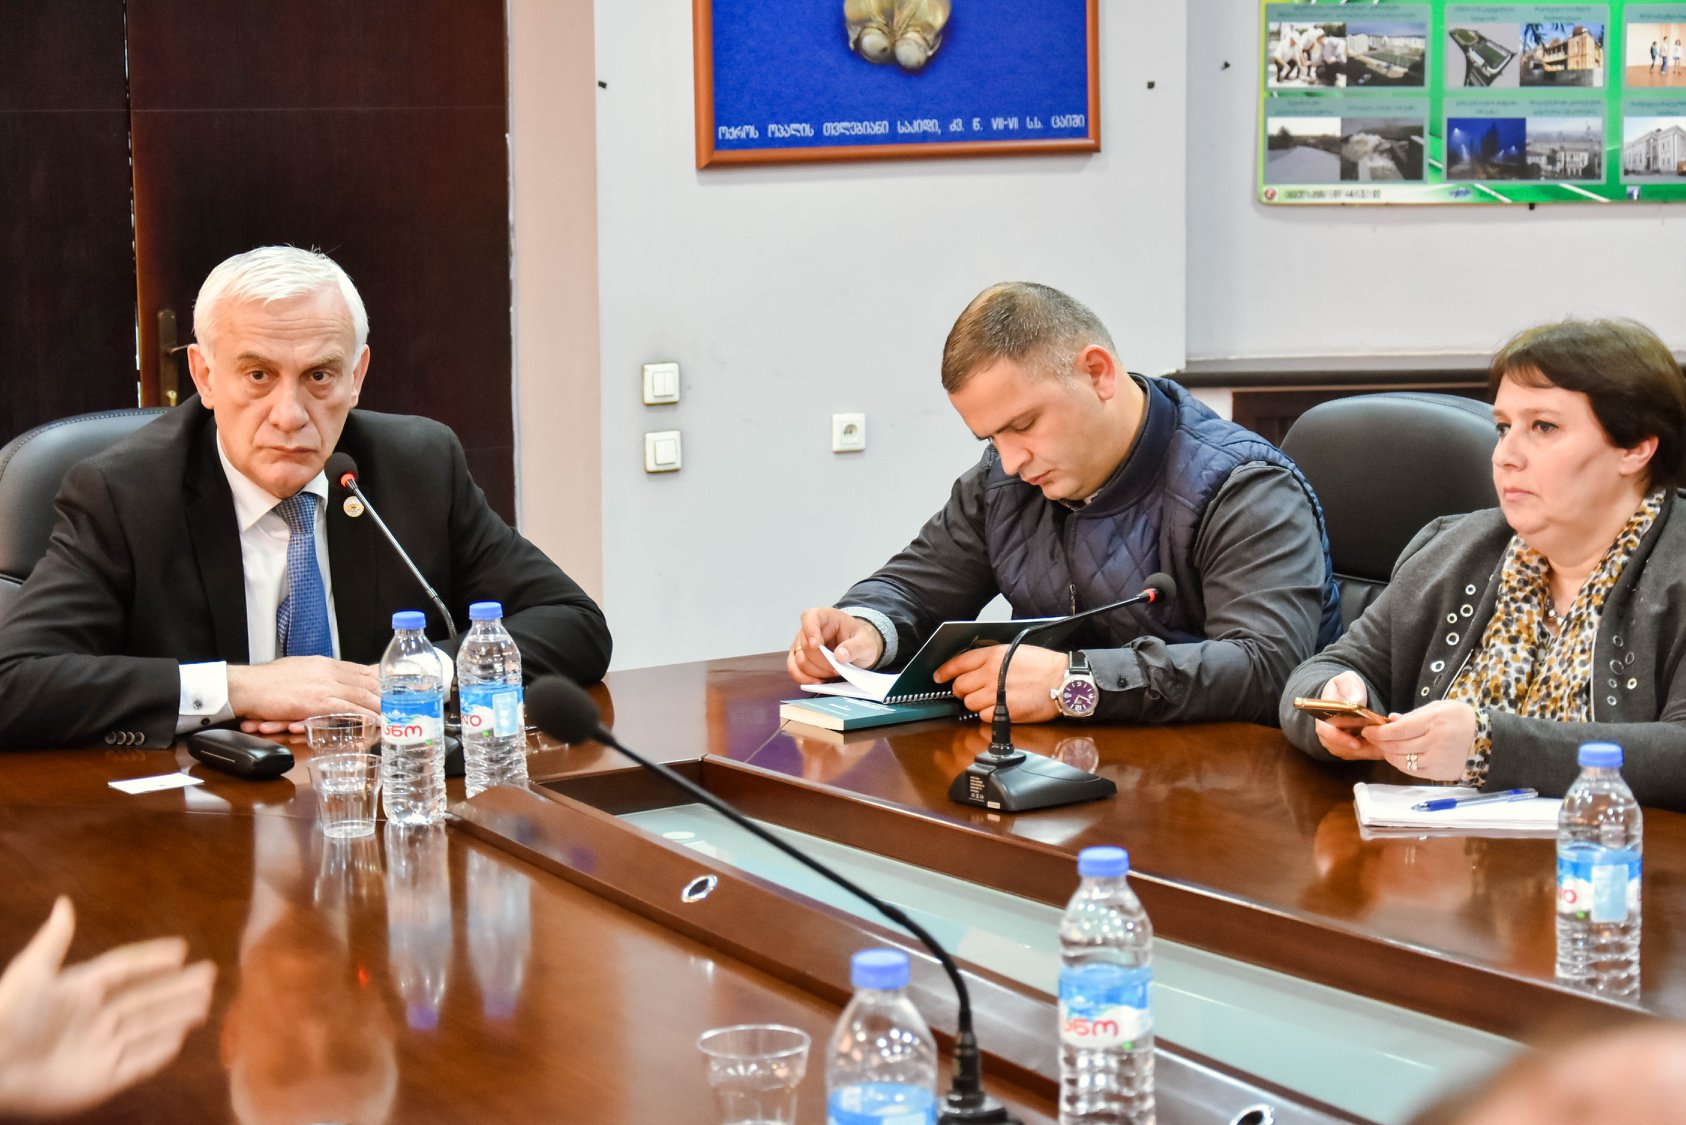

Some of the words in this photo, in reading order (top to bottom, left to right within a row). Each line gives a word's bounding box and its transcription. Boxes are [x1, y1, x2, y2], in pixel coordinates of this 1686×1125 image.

[718, 125, 759, 140] ოქროს
[823, 120, 889, 136] თვლებიანი
[991, 116, 1019, 131] VII-VI
[461, 713, 482, 727] NO
